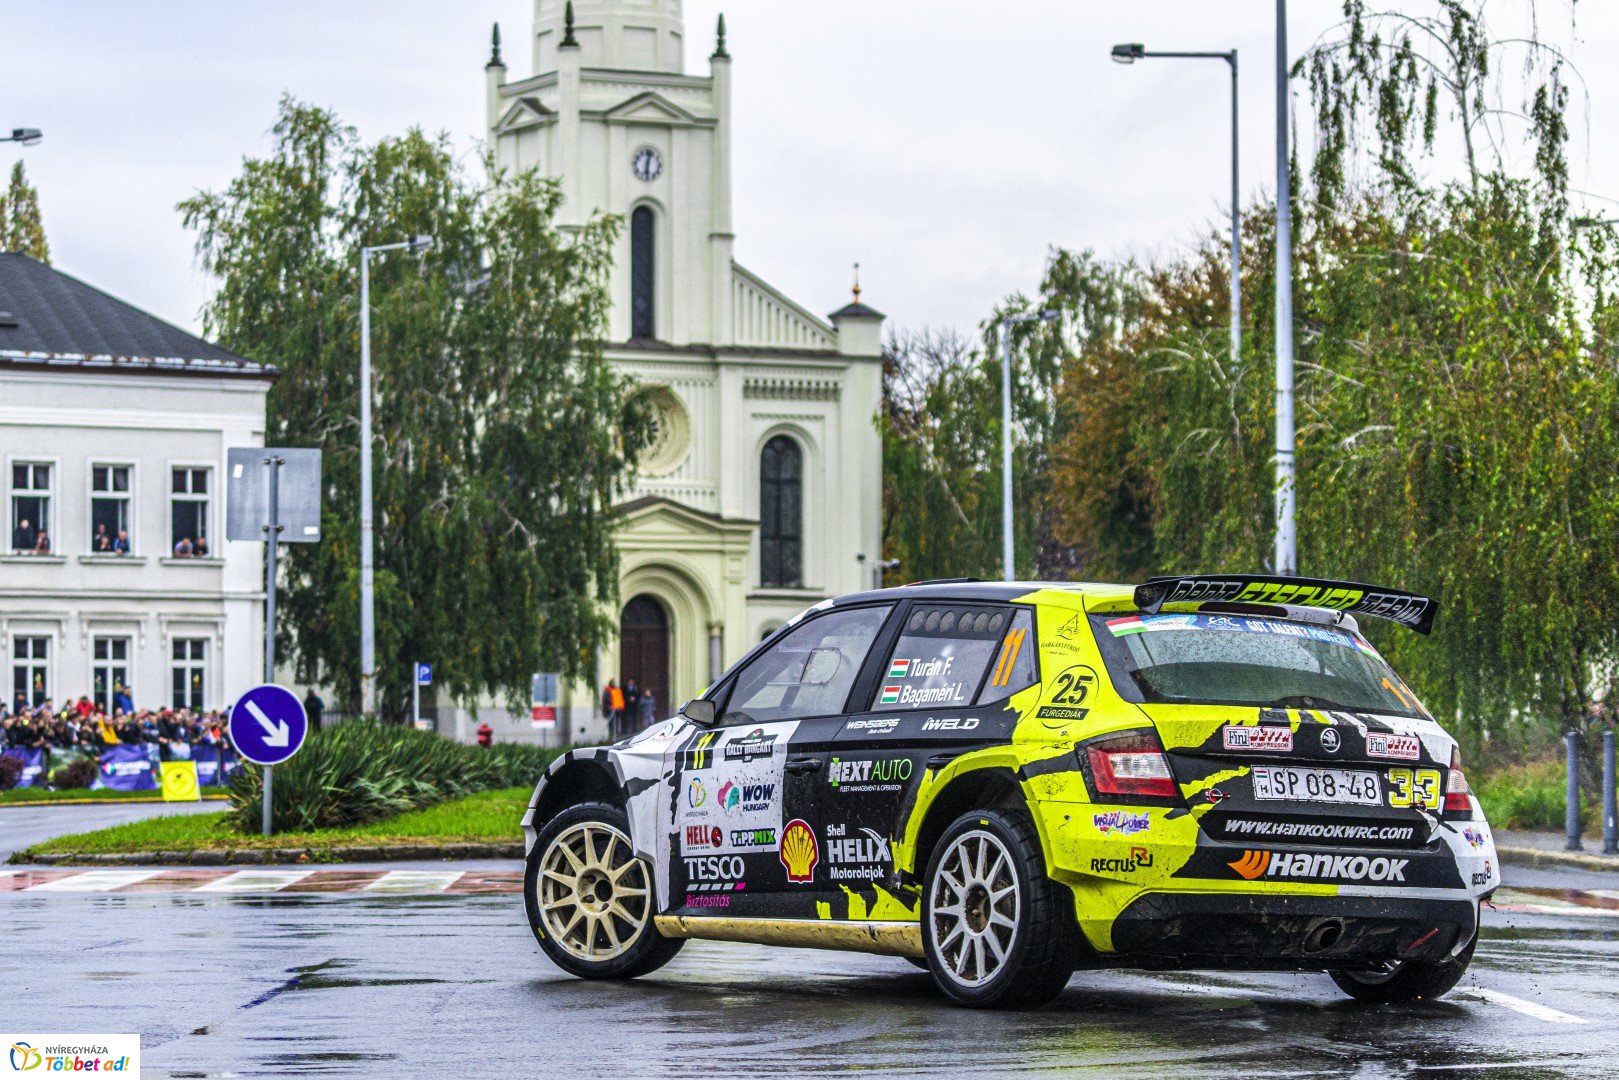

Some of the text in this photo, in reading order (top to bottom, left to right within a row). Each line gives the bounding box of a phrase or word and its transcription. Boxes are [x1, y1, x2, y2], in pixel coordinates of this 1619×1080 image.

[1245, 620, 1269, 633] GOT
[992, 627, 1027, 687] 11
[420, 665, 430, 679] P
[911, 657, 955, 677] Turán F.
[901, 683, 965, 708] Bagaméri L.
[1051, 673, 1094, 706] 25
[726, 739, 774, 756] RALLY HUNGARY
[1228, 731, 1248, 745] Fini
[1370, 738, 1386, 752] Fini
[828, 758, 913, 783] NEXT AUTO
[743, 783, 775, 802] WOW
[1273, 770, 1299, 796] SP
[1306, 772, 1378, 800] 08-48
[1387, 767, 1442, 809] 33
[742, 803, 770, 812] HUNGARY
[686, 825, 710, 846] HELL
[826, 823, 846, 837] Shell
[827, 838, 892, 863] HELIX
[684, 856, 745, 880] TESCO
[830, 865, 885, 882] Motorolajok
[1090, 858, 1137, 873] RECTUS
[686, 894, 731, 908] Biztosítás
